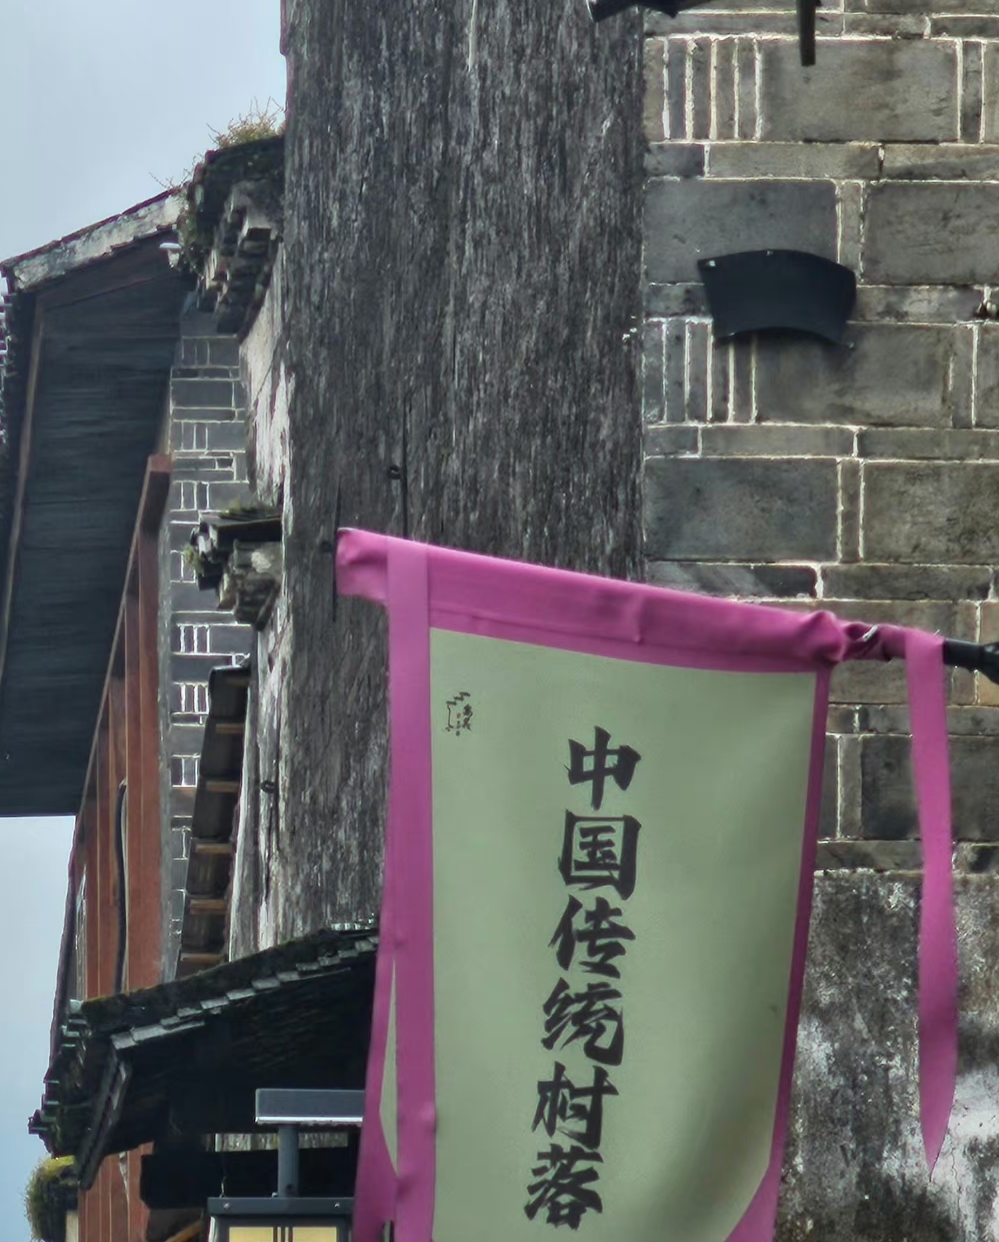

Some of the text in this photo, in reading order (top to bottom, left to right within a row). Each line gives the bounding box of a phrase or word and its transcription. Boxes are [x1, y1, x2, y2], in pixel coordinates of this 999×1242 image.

[524, 725, 642, 1231] 中国传统村落
